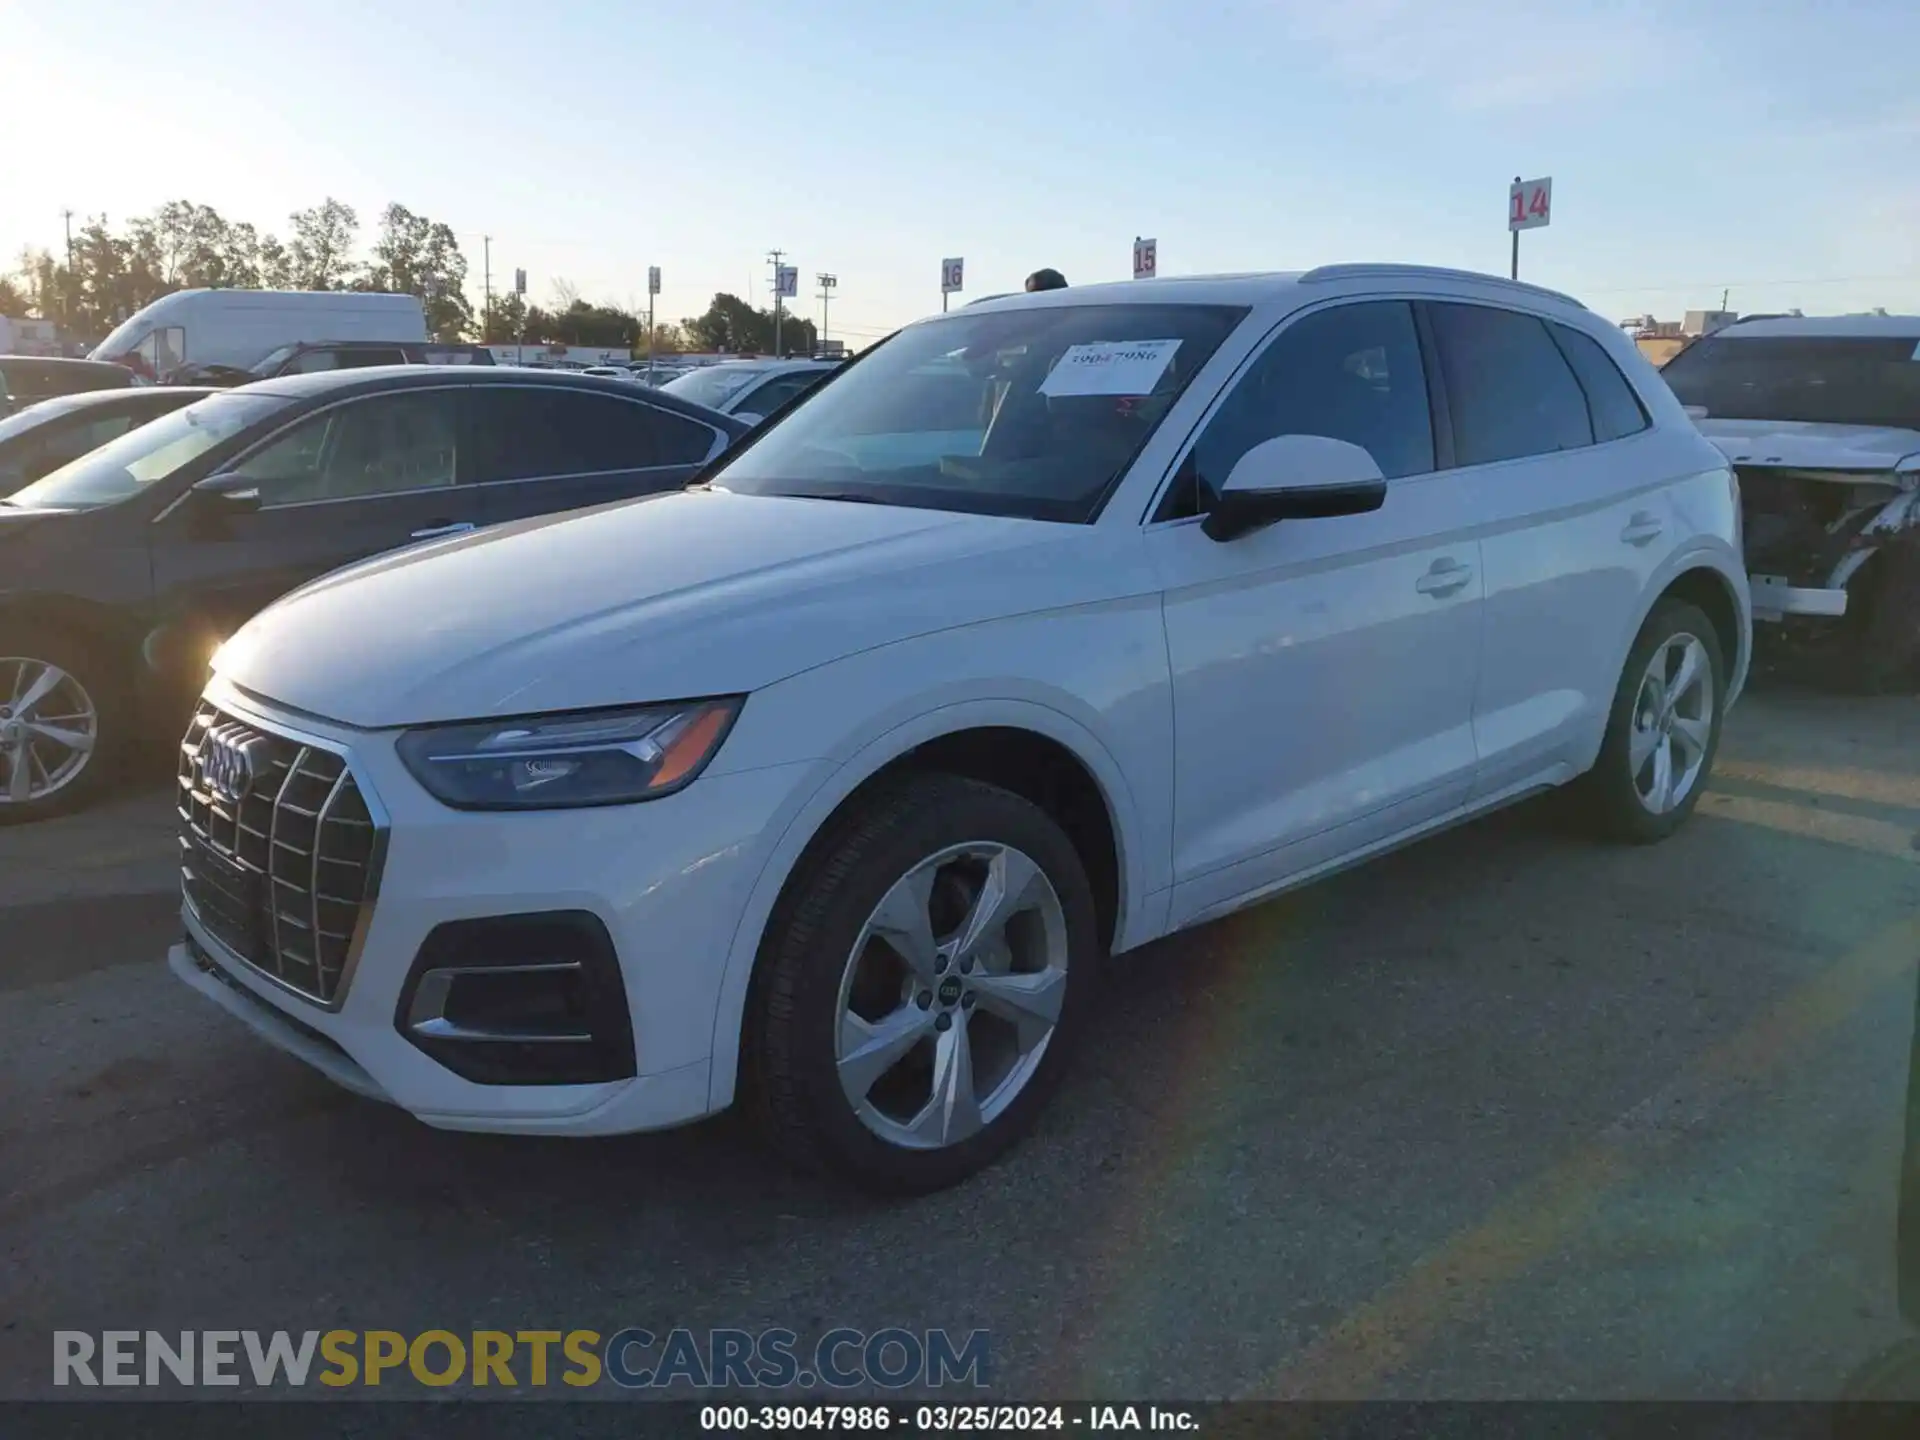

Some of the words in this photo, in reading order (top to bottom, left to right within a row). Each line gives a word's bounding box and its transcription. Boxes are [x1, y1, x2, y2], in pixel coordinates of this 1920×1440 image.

[1511, 187, 1549, 222] 14
[1134, 246, 1156, 272] 15
[778, 272, 797, 292] 17
[942, 264, 962, 287] 16
